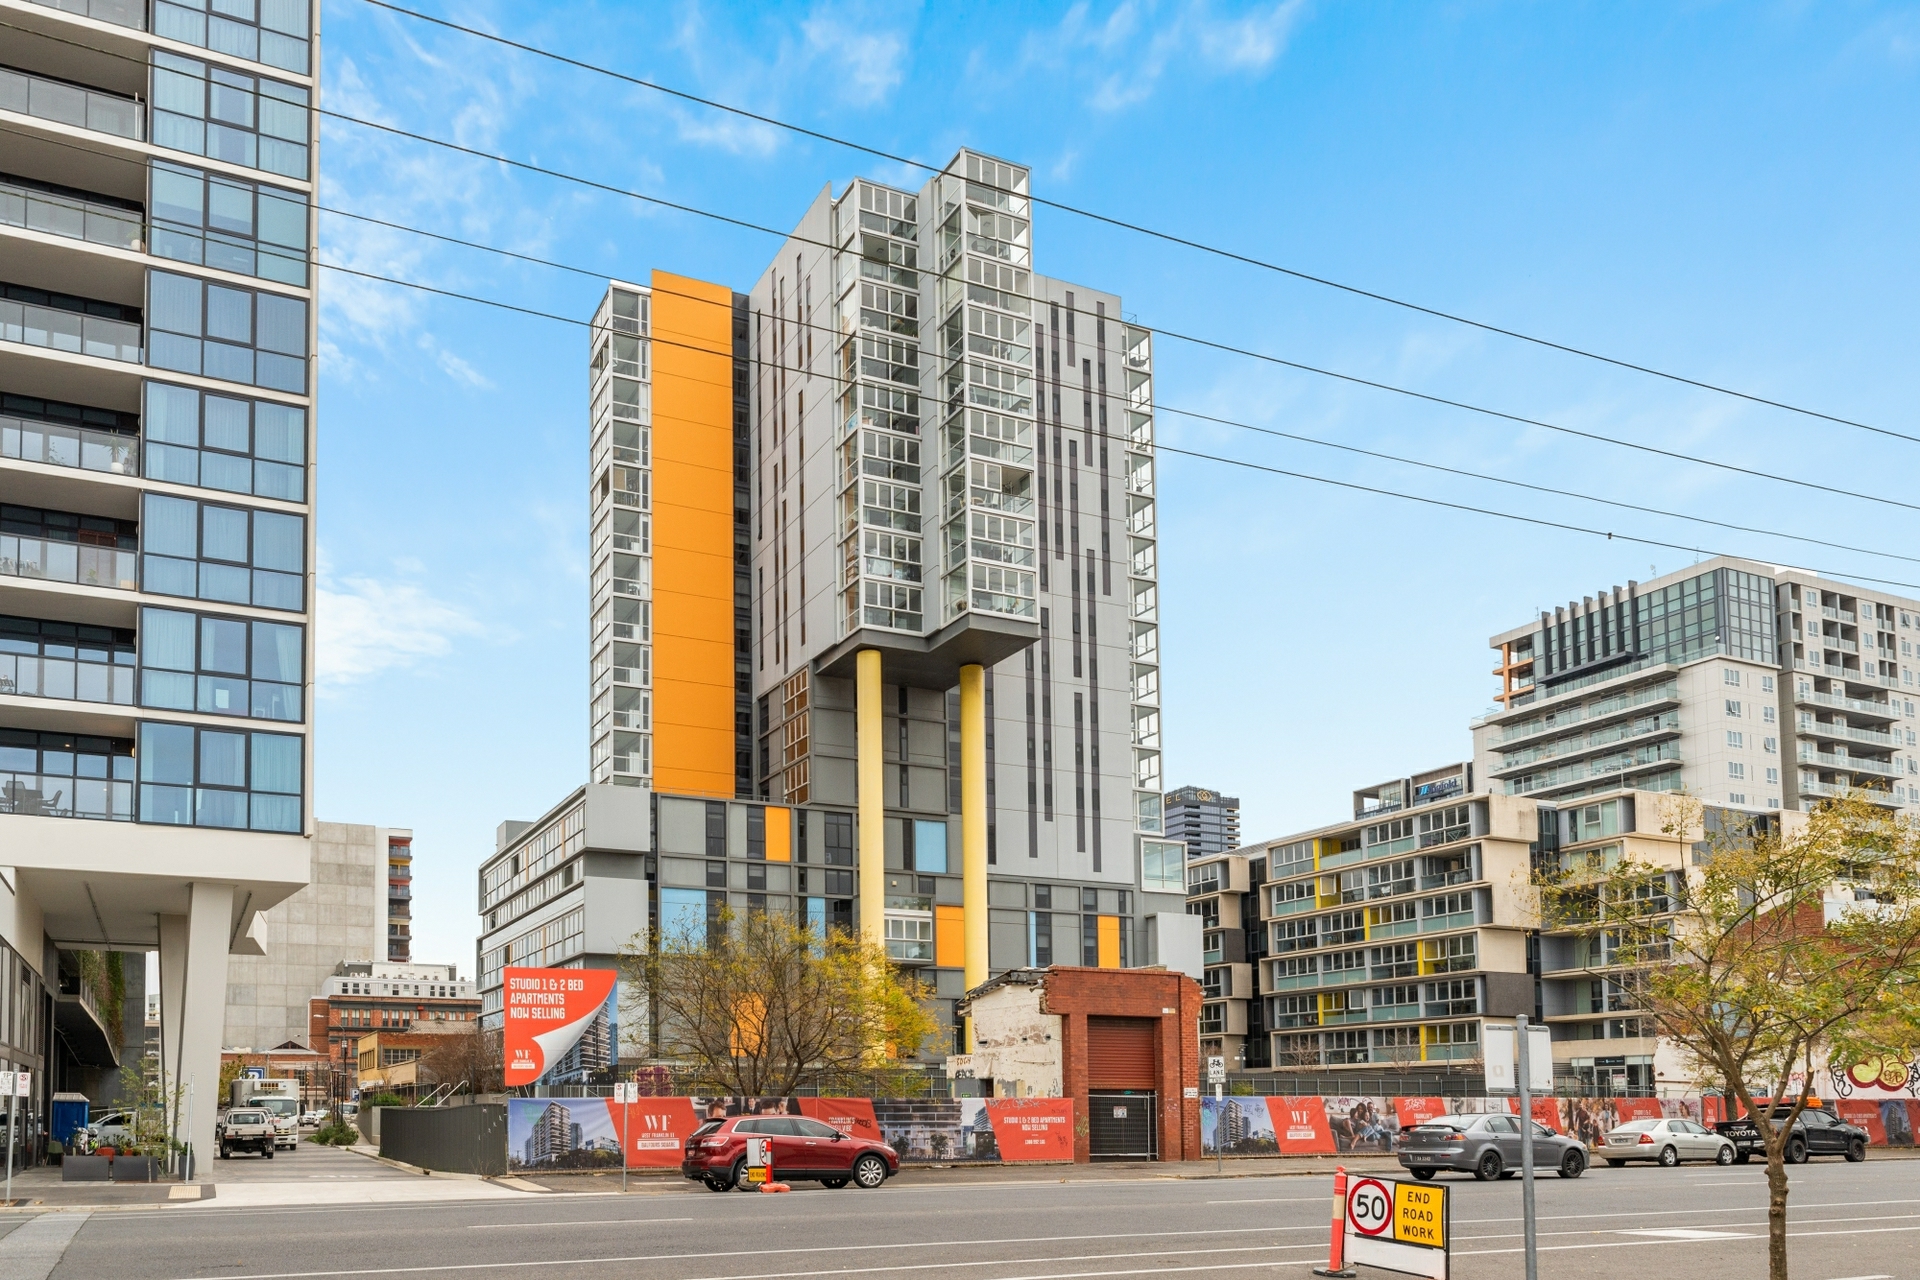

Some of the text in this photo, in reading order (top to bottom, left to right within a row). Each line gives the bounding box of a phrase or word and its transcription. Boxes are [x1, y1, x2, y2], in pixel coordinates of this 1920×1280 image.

[510, 978, 583, 991] STUDIO 1 & 2 BED
[510, 993, 565, 1005] APARTMENTS
[510, 1007, 565, 1019] NOW SELLING
[515, 1049, 531, 1059] WF
[644, 1115, 672, 1131] WF
[1040, 1116, 1065, 1124] APARTMENTS
[1291, 1110, 1310, 1124] WF
[1407, 1191, 1430, 1204] END
[1356, 1194, 1385, 1221] 50
[1403, 1207, 1433, 1222] ROAD
[1403, 1225, 1435, 1240] WORK
